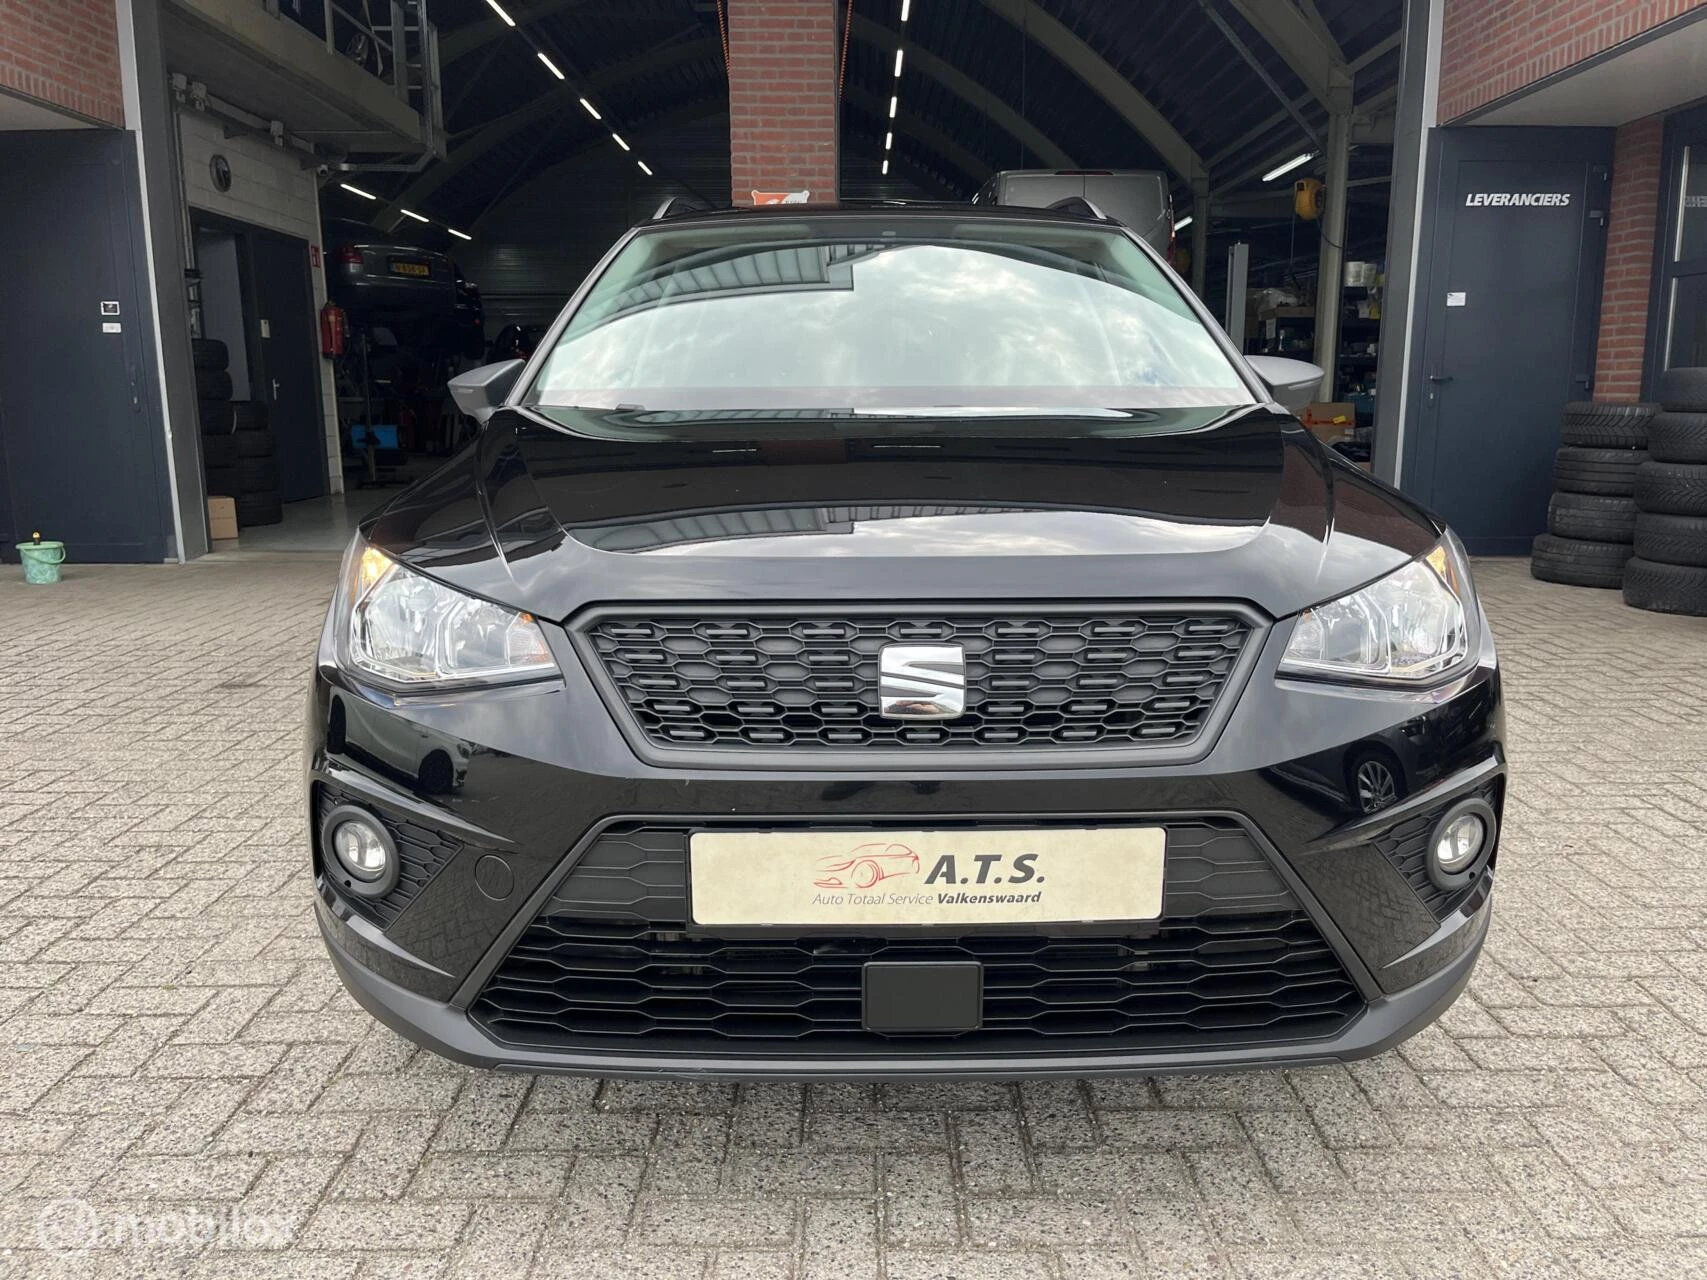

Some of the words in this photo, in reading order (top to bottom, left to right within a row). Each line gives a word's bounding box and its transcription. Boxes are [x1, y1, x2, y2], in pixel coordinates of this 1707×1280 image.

[1465, 193, 1571, 206] LEVERANCIERS
[924, 853, 1045, 885] A.T.S.
[812, 894, 844, 905] Auto
[847, 893, 885, 905] Totaal
[888, 893, 934, 905] Service
[938, 891, 1042, 905] Valkenswaard
